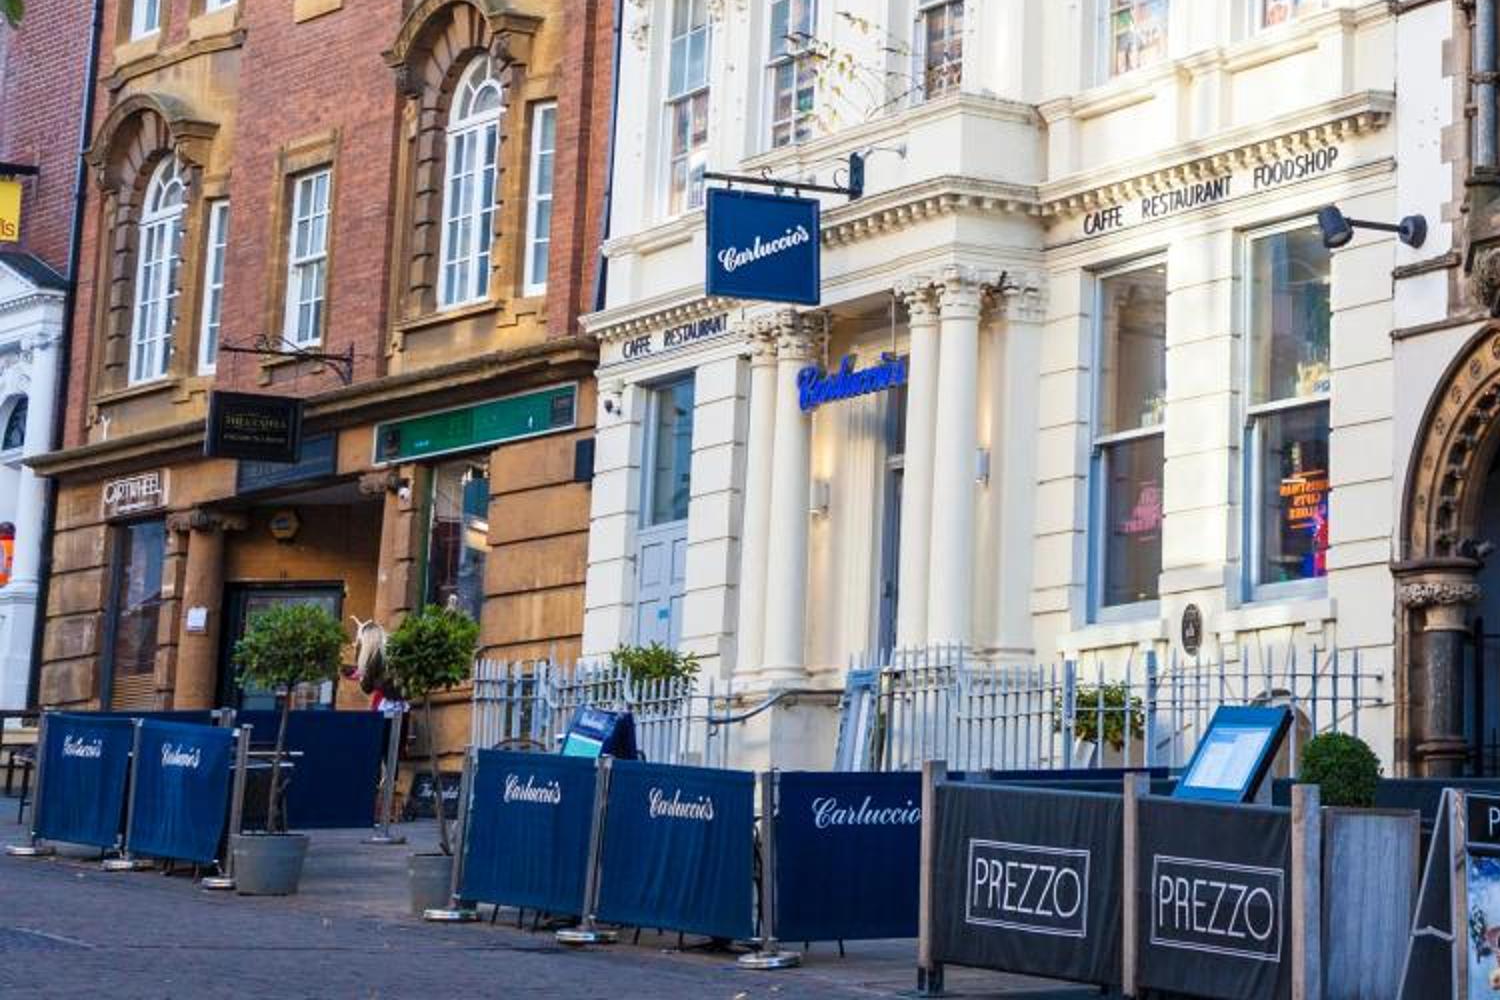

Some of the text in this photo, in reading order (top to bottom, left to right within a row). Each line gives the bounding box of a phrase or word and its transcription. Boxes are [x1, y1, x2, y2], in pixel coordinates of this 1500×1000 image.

[1083, 146, 1339, 235] CAFFE RESTAURANT FOODSHOP
[622, 313, 728, 359] CAFFE RESTAURANT
[973, 858, 1081, 918] PREZZO
[1158, 875, 1274, 940] PREZZO
